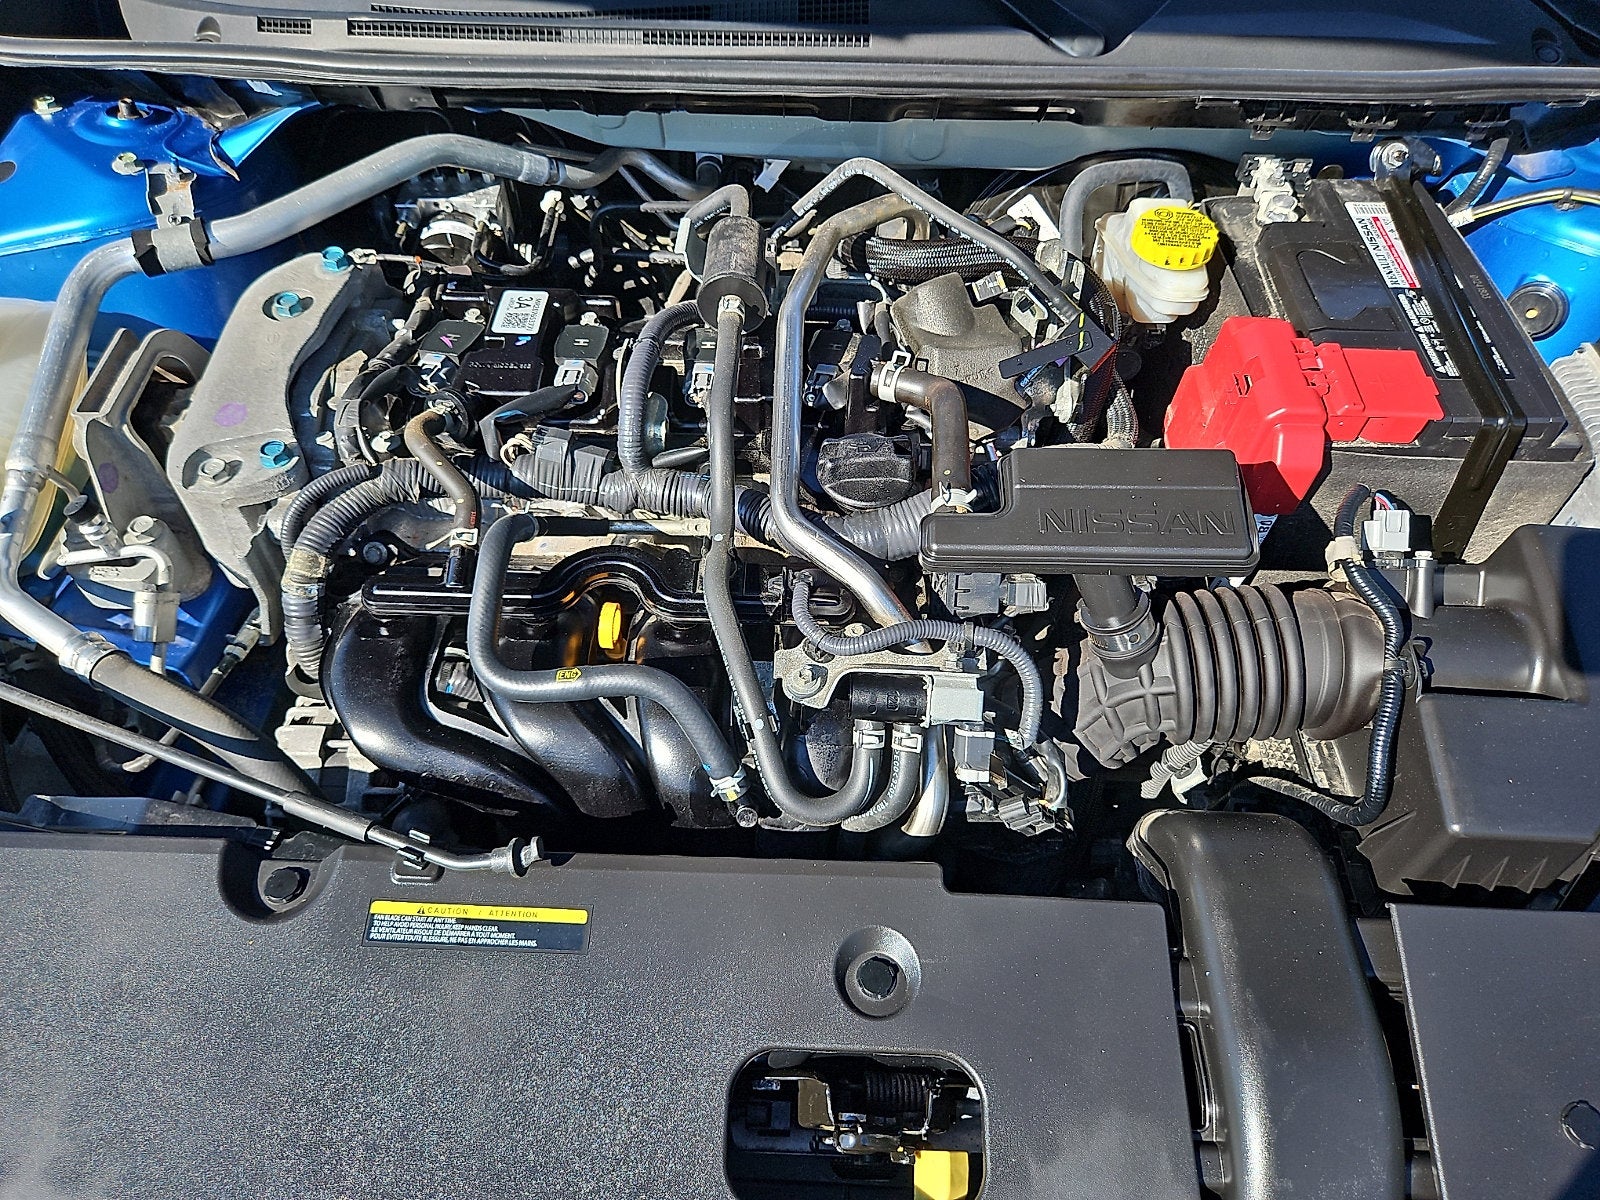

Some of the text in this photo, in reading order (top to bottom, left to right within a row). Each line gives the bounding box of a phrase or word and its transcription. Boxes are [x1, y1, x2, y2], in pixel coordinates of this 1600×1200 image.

[1356, 217, 1381, 251] NISSAN
[1375, 252, 1400, 285] RENAULT
[514, 296, 533, 310] 3A
[1038, 508, 1236, 535] NISSAN
[427, 906, 470, 915] CAUTION
[489, 909, 539, 918] ATTENTION
[405, 934, 422, 942] TOUTE
[476, 937, 509, 945] APPROCHER
